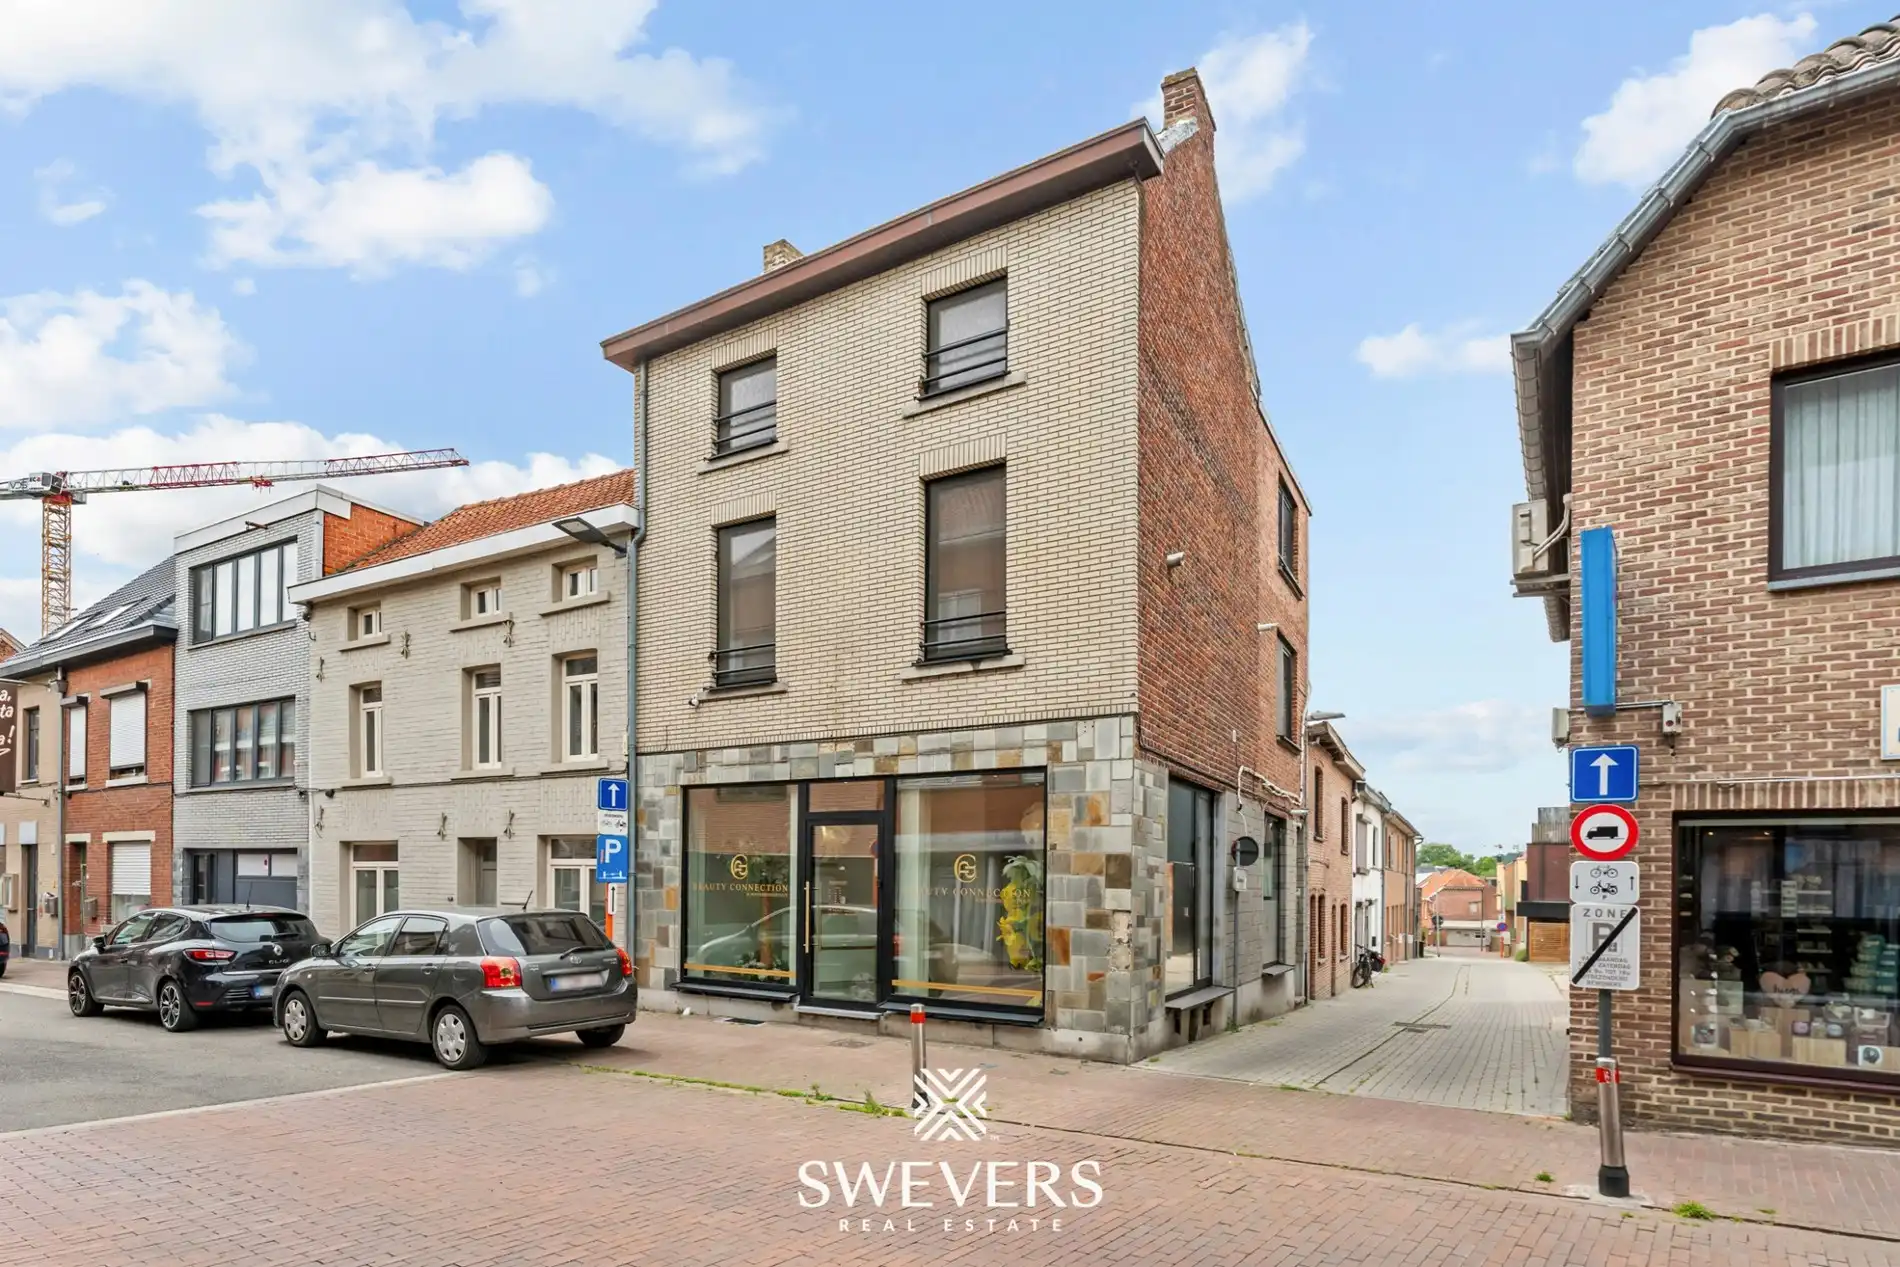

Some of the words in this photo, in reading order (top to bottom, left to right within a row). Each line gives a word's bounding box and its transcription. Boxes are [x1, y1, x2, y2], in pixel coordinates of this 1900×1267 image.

[605, 839, 622, 864] P
[729, 883, 788, 892] CONNECTION
[1583, 908, 1627, 918] ZONE
